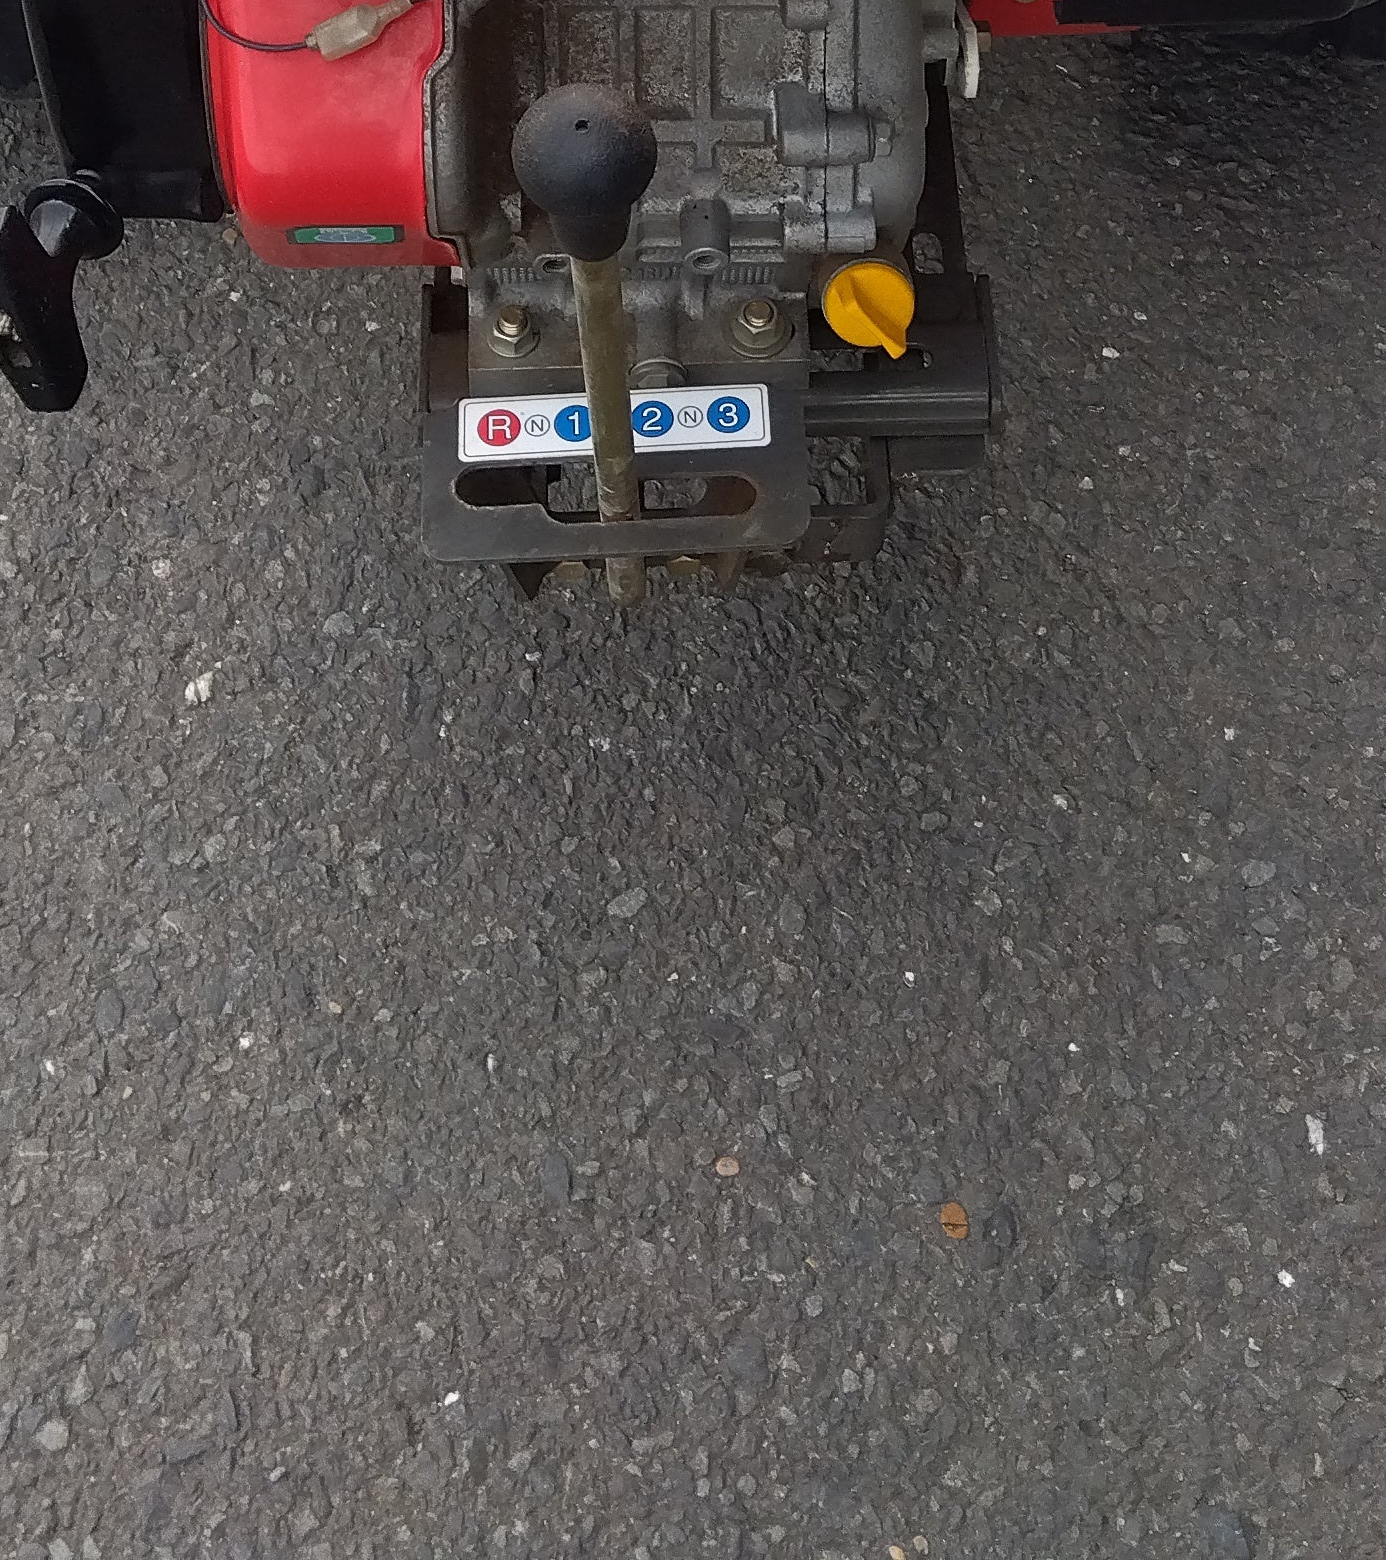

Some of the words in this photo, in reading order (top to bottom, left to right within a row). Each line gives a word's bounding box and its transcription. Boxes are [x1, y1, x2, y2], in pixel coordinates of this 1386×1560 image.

[487, 415, 511, 440] R
[530, 418, 544, 433] N
[568, 411, 581, 435] 1
[642, 407, 662, 431] 2
[684, 409, 698, 425] N
[718, 403, 738, 427] 3
